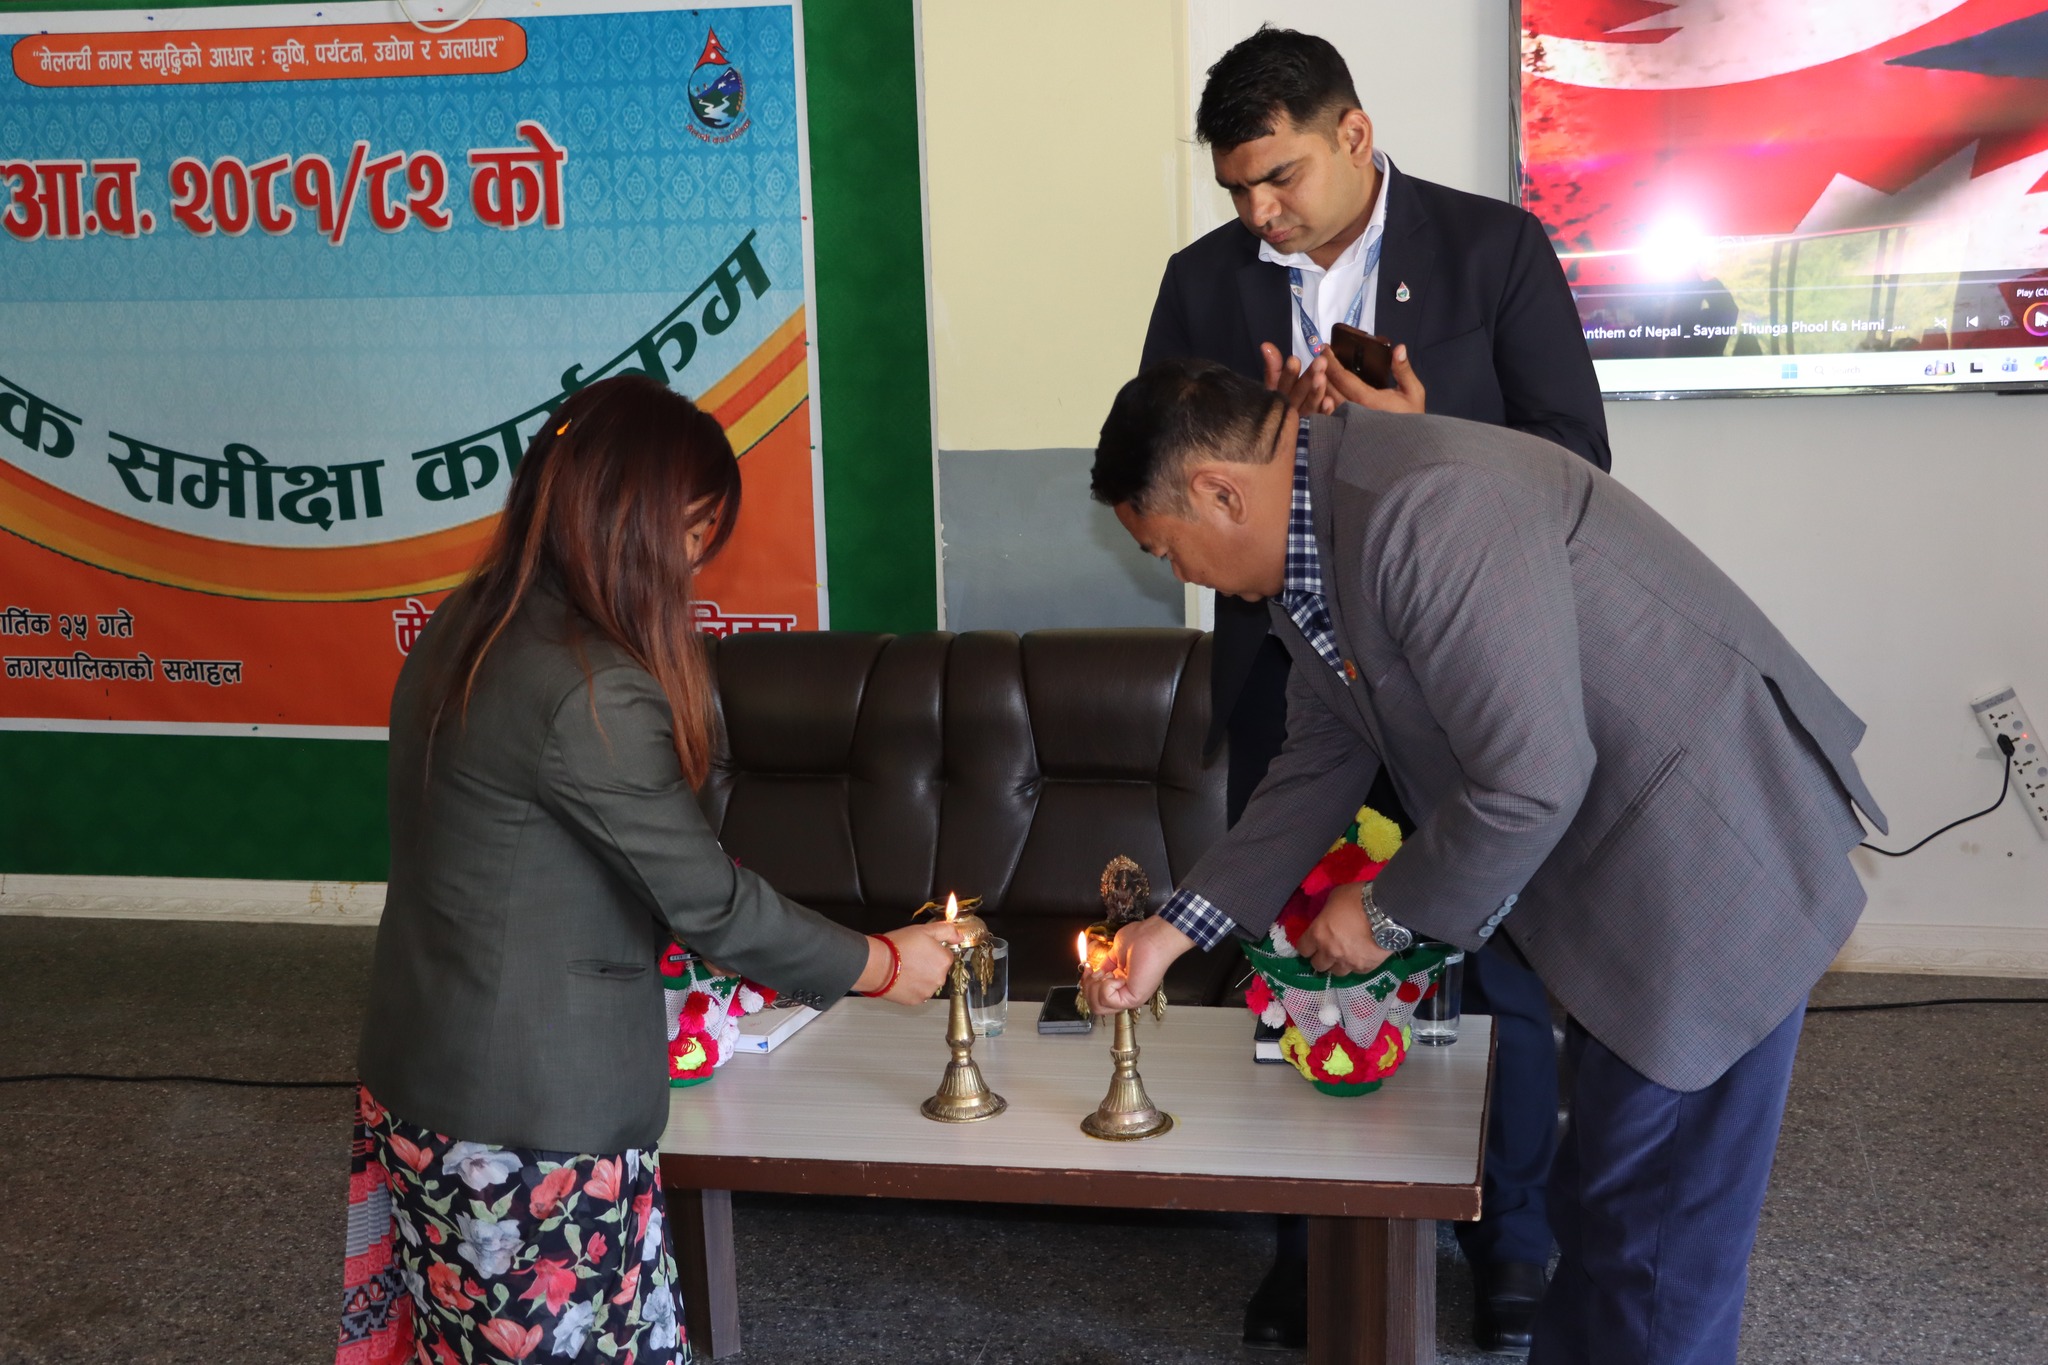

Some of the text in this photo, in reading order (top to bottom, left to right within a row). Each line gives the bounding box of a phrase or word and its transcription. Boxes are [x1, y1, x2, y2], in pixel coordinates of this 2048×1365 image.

[98, 51, 133, 71] नगर
[210, 47, 254, 68] आधार
[272, 39, 309, 72] कृषि,
[315, 39, 368, 64] पर्यटन,
[373, 35, 414, 62] उद्योग
[420, 40, 432, 61] र
[0, 119, 568, 246] आ.व. २०८१/८२ को
[2016, 288, 2034, 298] Play
[1629, 326, 1642, 338] of
[1645, 324, 1681, 340] Nepal
[1693, 324, 1738, 339] Sayaun
[1741, 321, 1788, 337] Thunga
[1791, 319, 1828, 334] Phool
[1832, 319, 1847, 332] Ka
[1852, 318, 1885, 331] Hami
[108, 430, 385, 531] समीक्षा
[59, 613, 88, 640] २५
[97, 608, 134, 638] गते
[4, 650, 243, 686] नगरपालिकाको सभाहल
